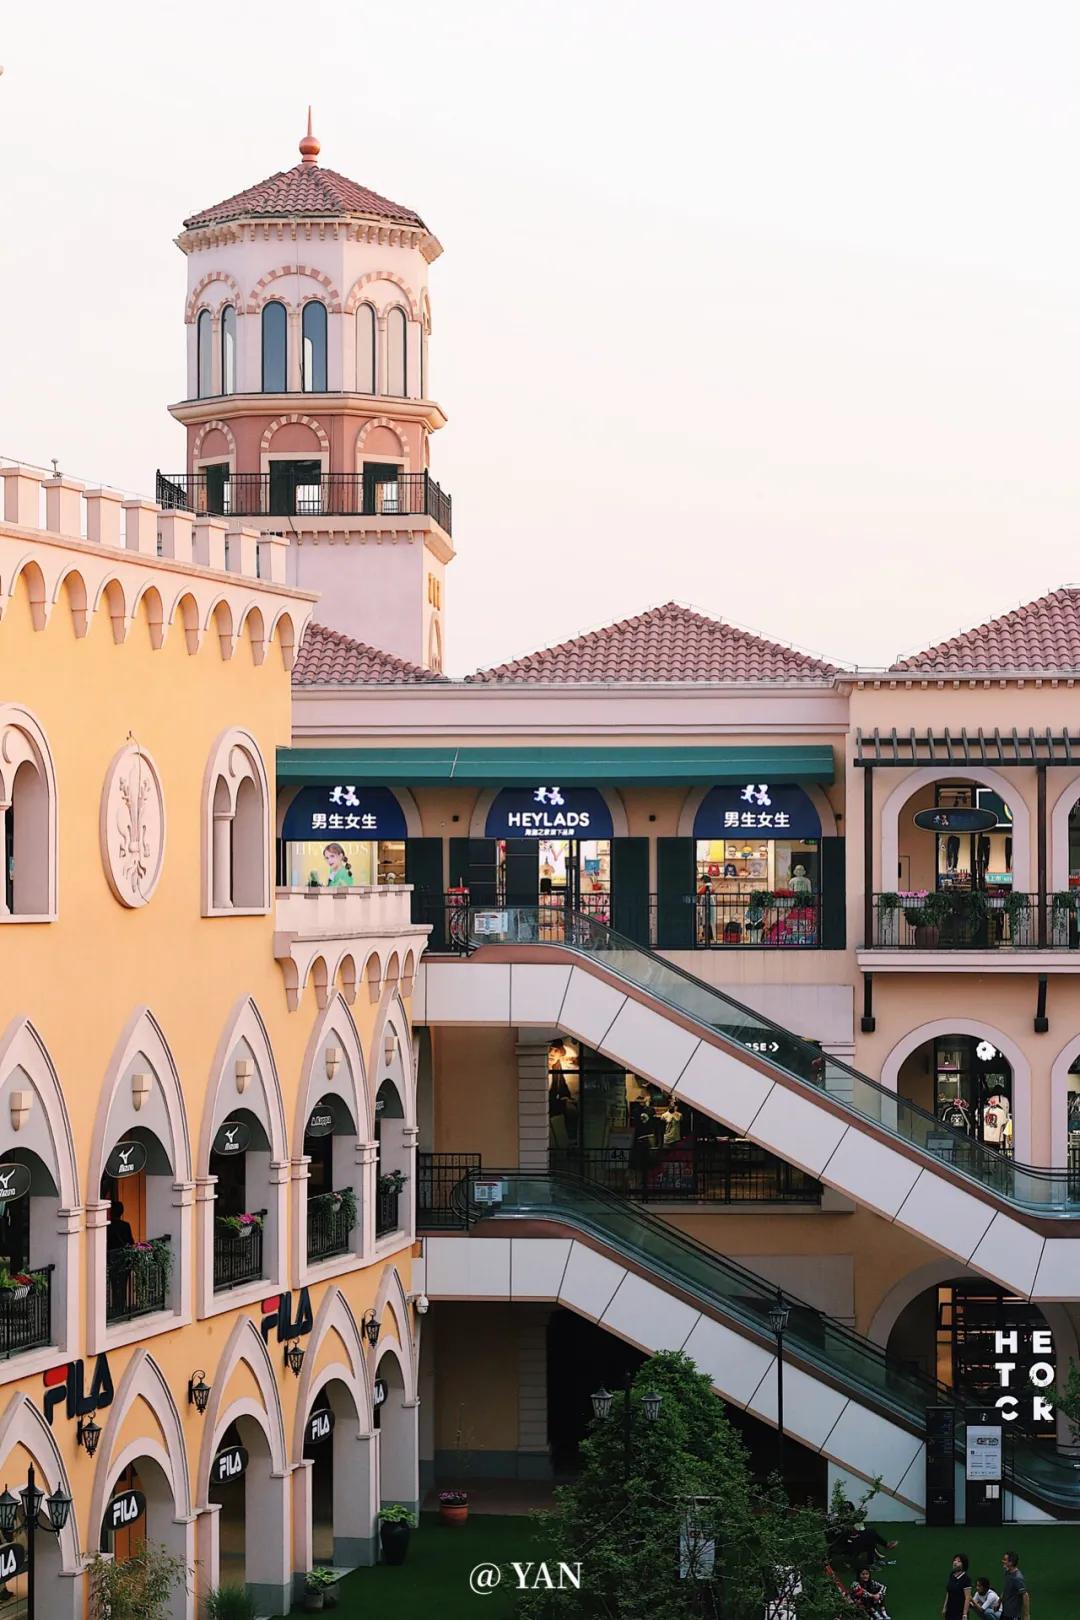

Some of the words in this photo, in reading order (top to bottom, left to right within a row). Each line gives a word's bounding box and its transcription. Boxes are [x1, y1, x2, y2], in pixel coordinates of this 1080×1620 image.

[311, 812, 378, 829] 男生女生
[507, 812, 590, 827] HEYLADS
[723, 811, 791, 828] 男生女生
[261, 1287, 313, 1345] FILA
[43, 1353, 114, 1426] FILA
[311, 1414, 331, 1440] FILA
[219, 1451, 242, 1480] FILA
[112, 1495, 138, 1526] FILA
[0, 1548, 17, 1579] LA
